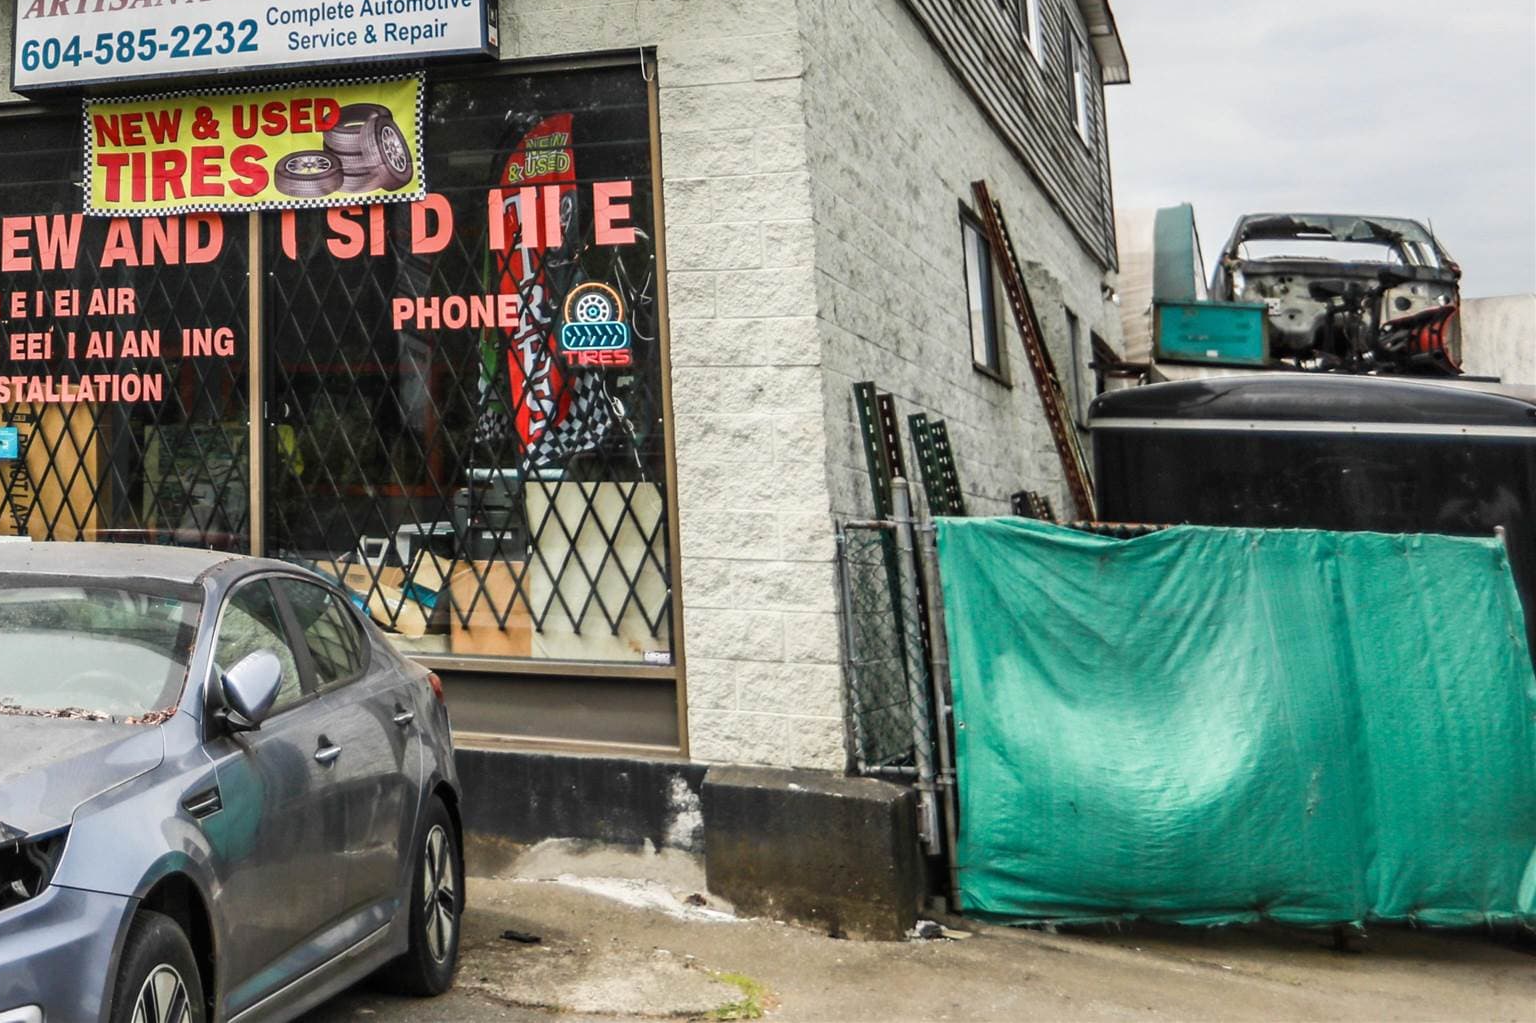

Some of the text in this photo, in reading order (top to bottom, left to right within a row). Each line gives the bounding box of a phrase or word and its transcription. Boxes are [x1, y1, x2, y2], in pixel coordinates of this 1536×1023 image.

[266, 1, 355, 27] Complete
[21, 18, 259, 71] 604-585-2232
[287, 19, 448, 52] Service & Repair
[93, 97, 341, 146] NEW & USED
[96, 144, 268, 202] TIRES
[508, 149, 570, 184] & USED
[100, 212, 224, 268] AND
[392, 294, 519, 330] PHONE
[562, 349, 630, 365] TIRES
